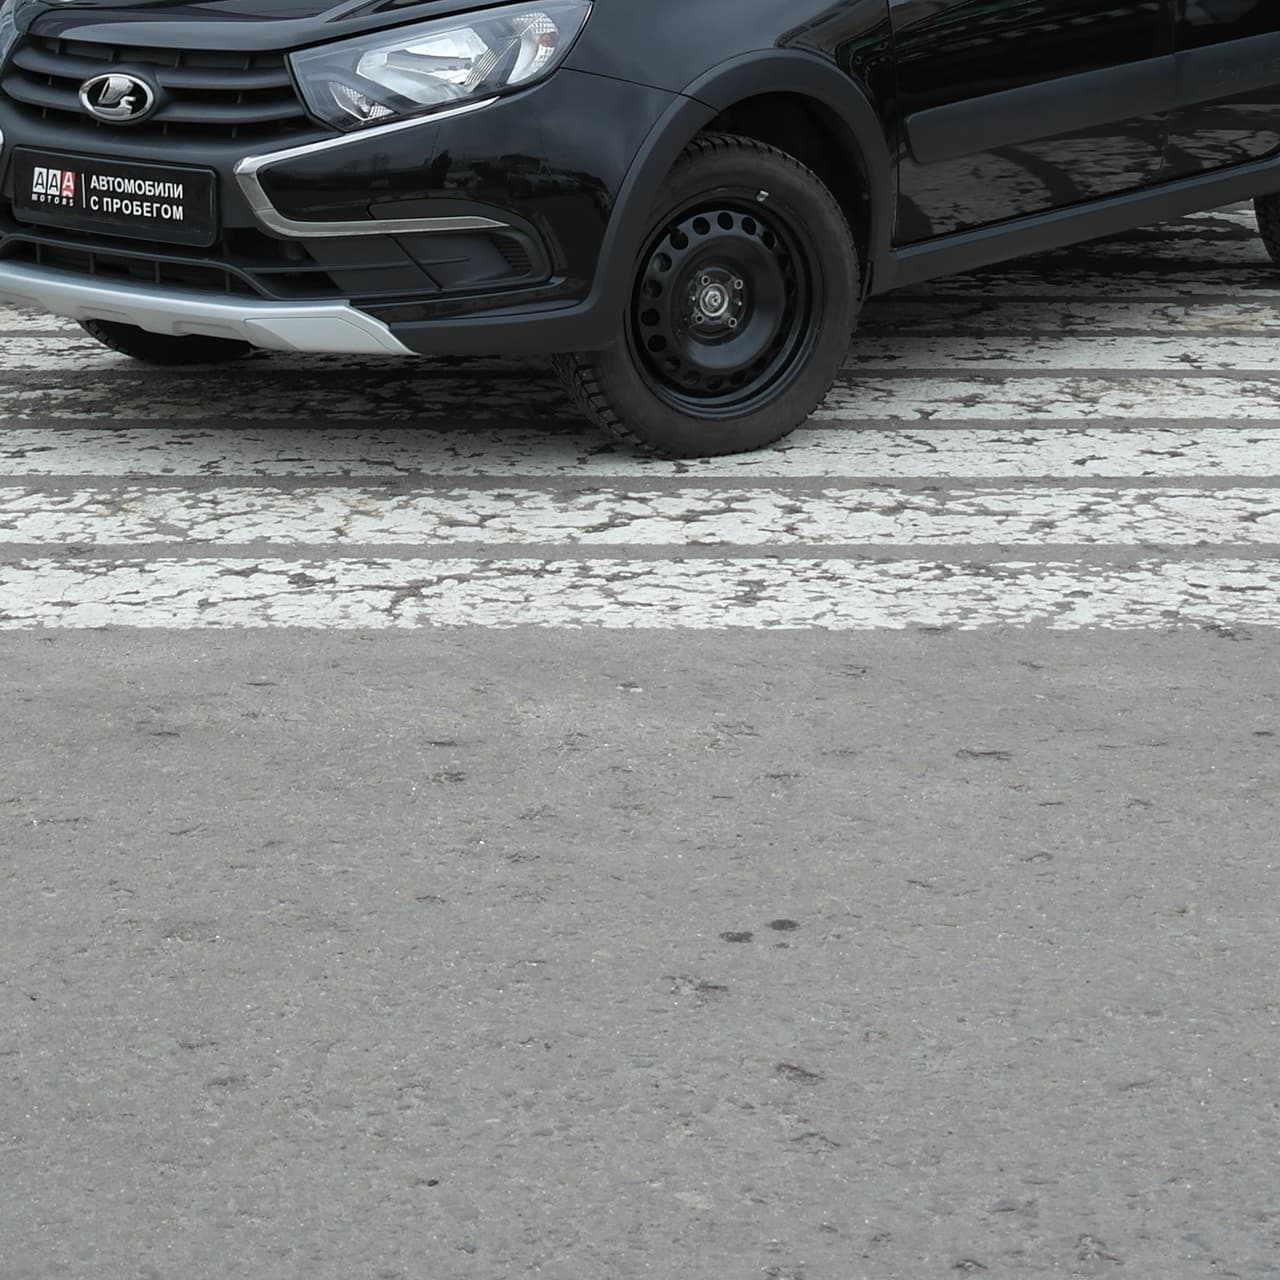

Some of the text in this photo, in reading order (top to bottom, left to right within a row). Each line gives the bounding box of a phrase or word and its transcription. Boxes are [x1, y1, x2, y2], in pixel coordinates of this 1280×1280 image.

[90, 174, 184, 199] АВТОМОБИЛИ
[32, 193, 74, 207] MOTORS
[90, 195, 184, 221] С ПРОБЕГОМ
